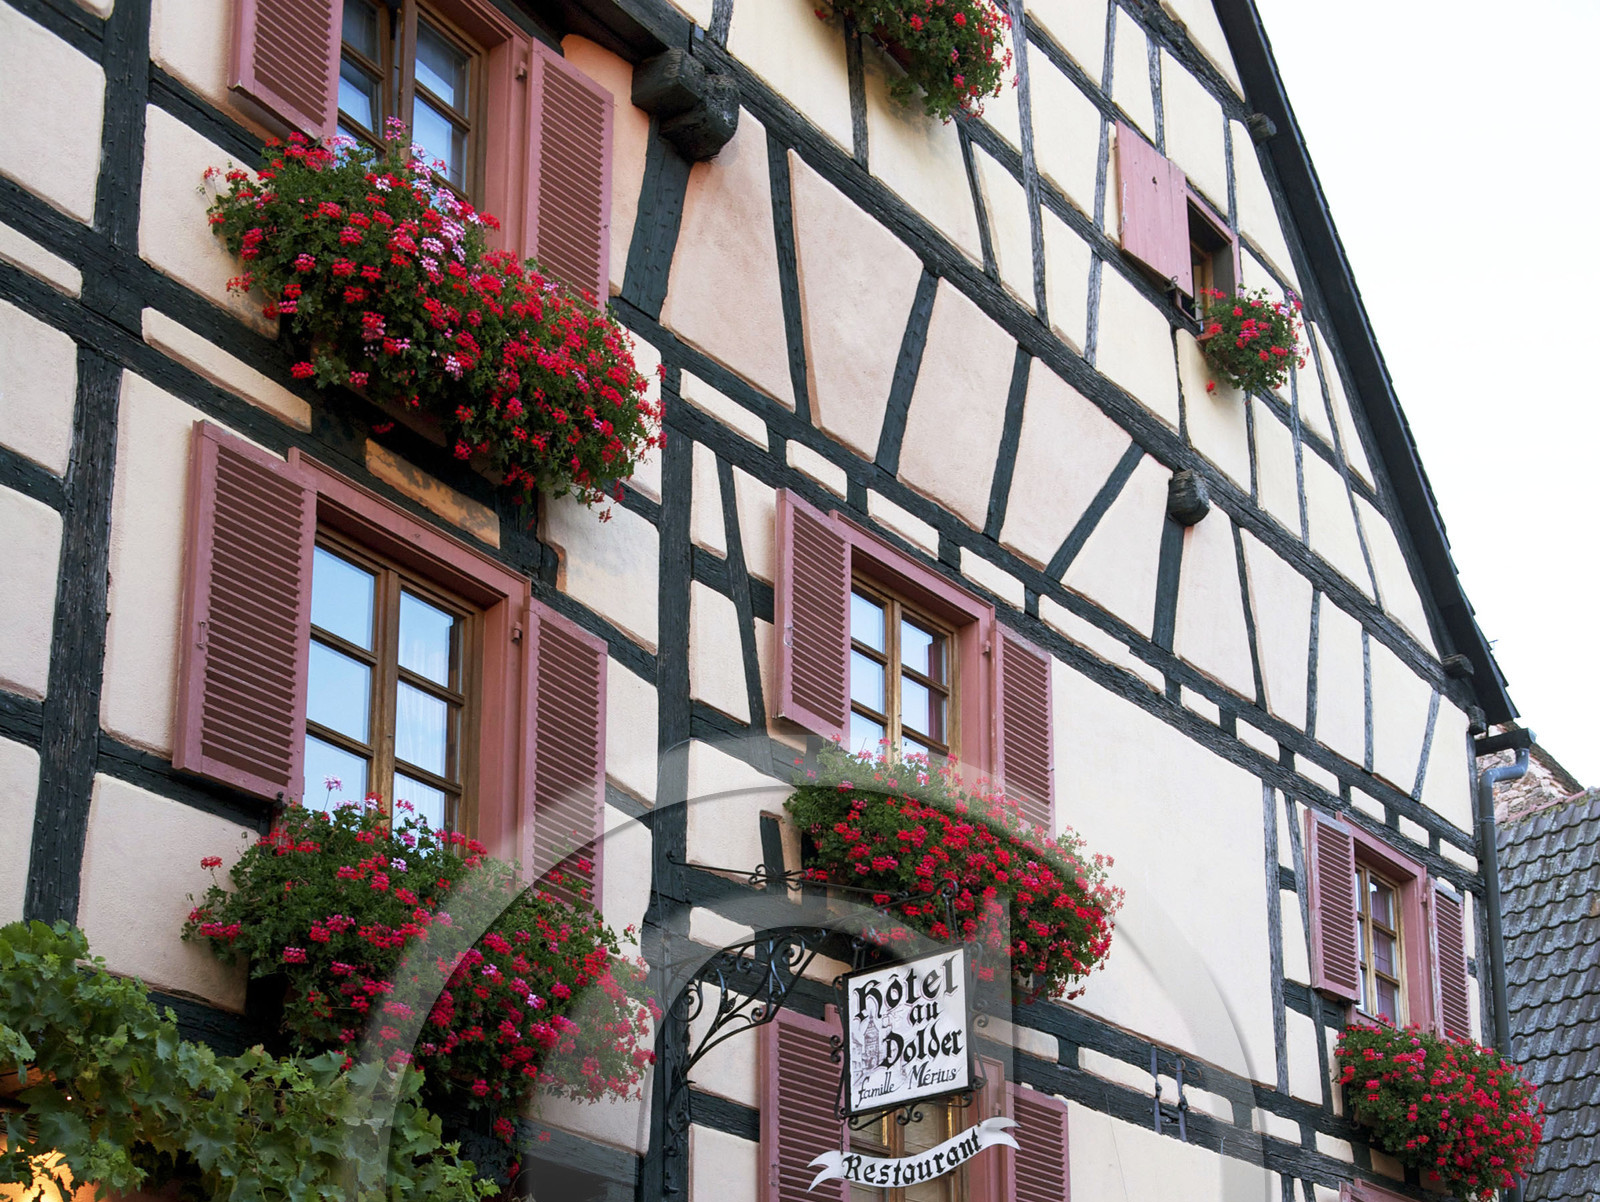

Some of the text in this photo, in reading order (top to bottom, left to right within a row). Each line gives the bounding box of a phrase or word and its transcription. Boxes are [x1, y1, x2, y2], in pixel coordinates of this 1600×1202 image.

[853, 954, 959, 1022] Hôtel
[909, 1000, 941, 1026] au
[878, 1018, 964, 1070] Dolder
[854, 1060, 961, 1109] famille Mérius
[841, 1127, 983, 1187] Restaurant
